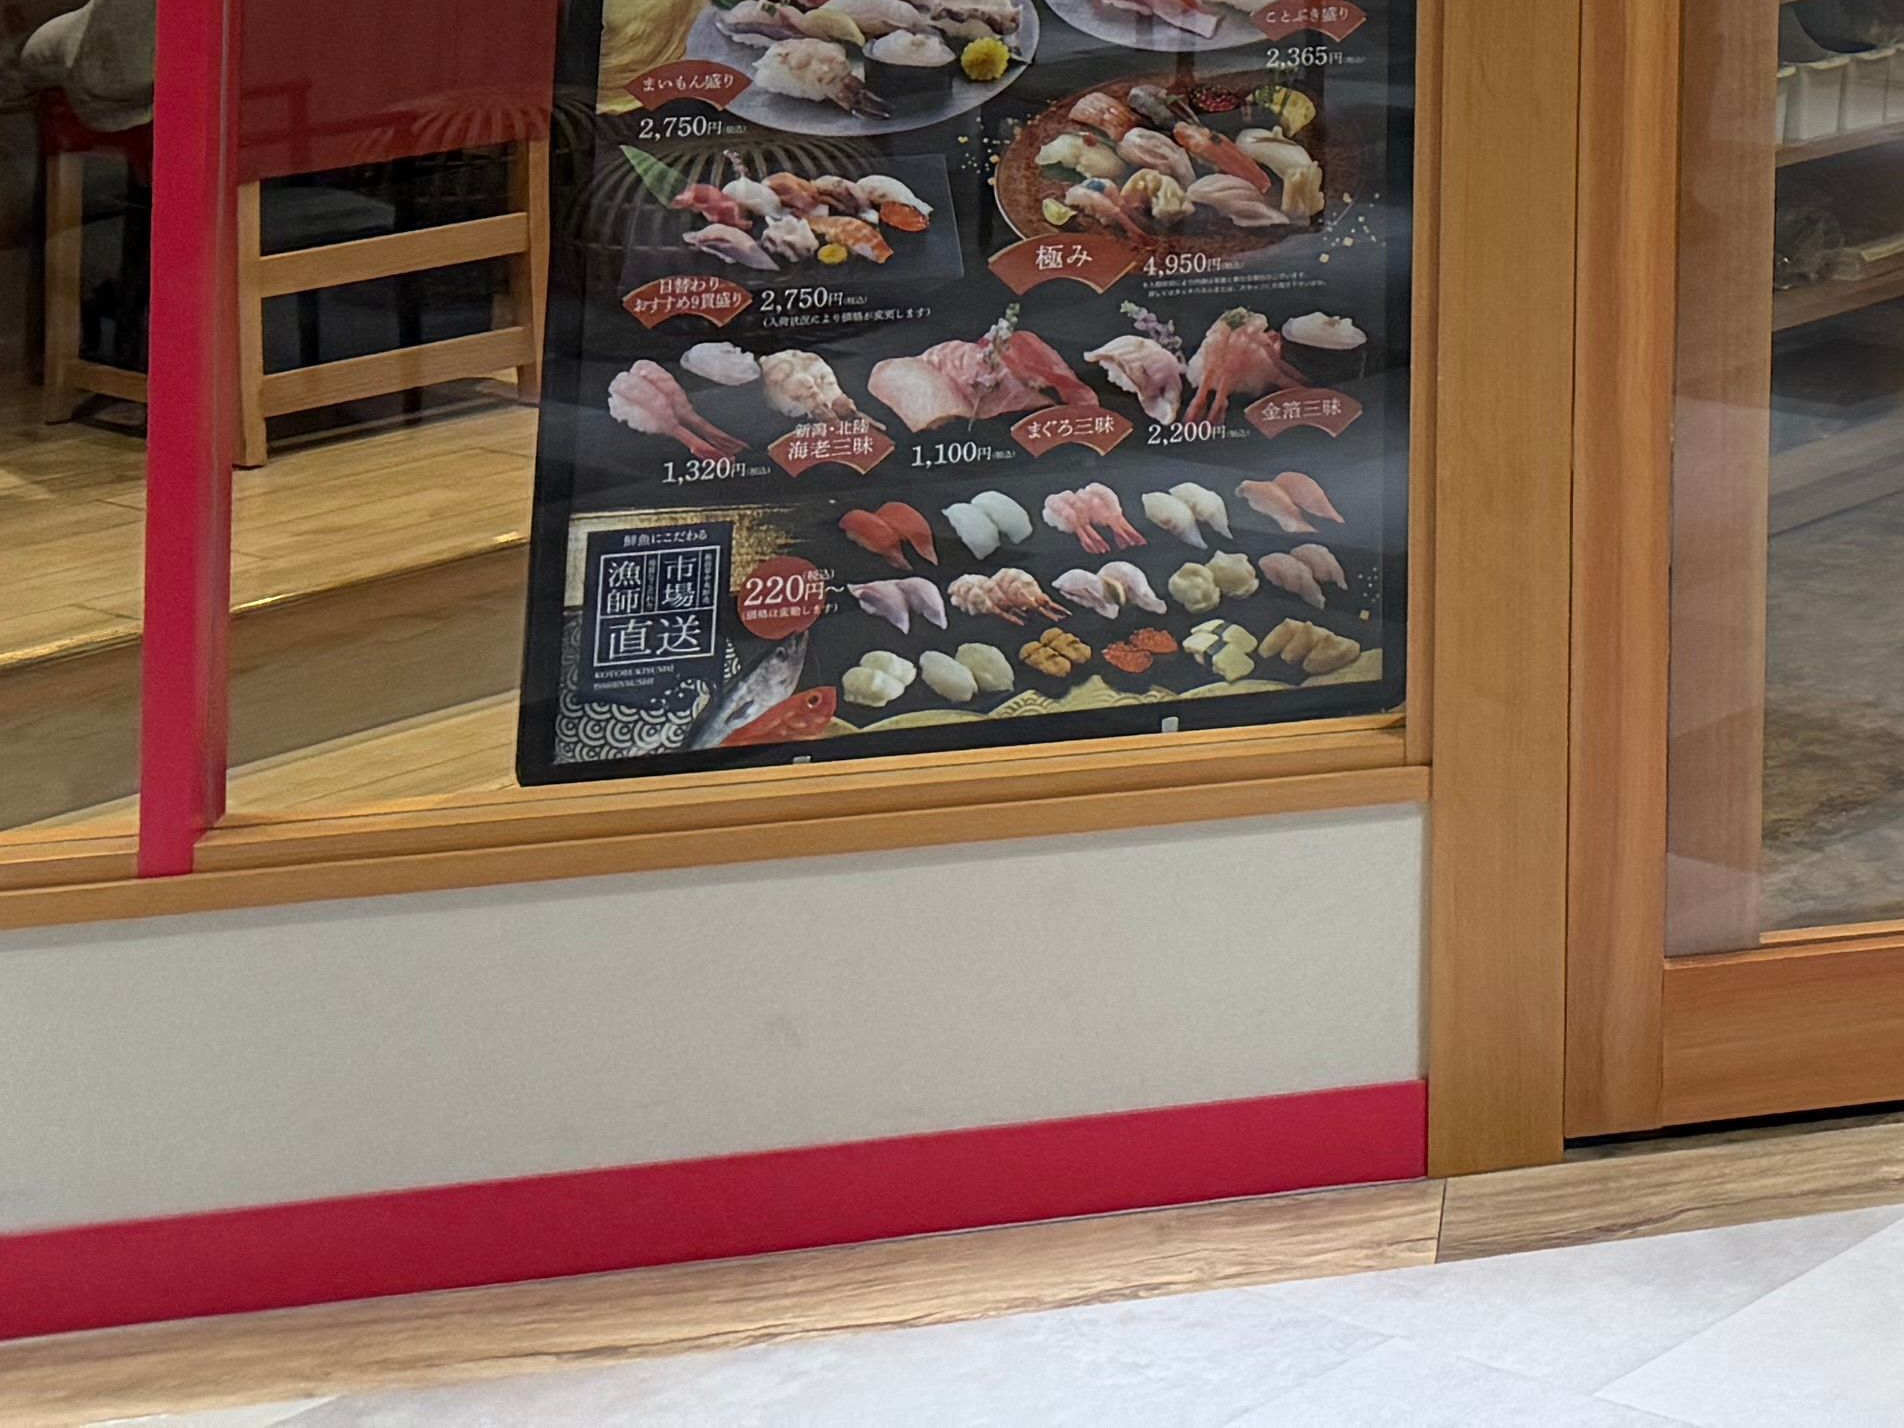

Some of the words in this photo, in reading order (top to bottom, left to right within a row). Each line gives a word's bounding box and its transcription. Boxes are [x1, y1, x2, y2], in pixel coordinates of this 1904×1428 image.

[1266, 46, 1343, 69] 2,365円
[642, 73, 734, 92] まいもん盛り
[638, 116, 722, 141] 2,750円
[1035, 243, 1093, 270] 極み
[1143, 253, 1221, 277] 4,950円
[660, 277, 719, 294] 日替わり
[759, 287, 843, 314] 2,750円
[1027, 417, 1115, 440] まぐろ三昧
[1147, 420, 1226, 446] 2,200円
[788, 436, 873, 461] 海老三昧
[912, 442, 992, 469] 1,100円
[662, 457, 746, 485] 1,320円
[607, 560, 641, 614] 漁師
[661, 554, 697, 608] 市場
[608, 614, 701, 660] 直送
